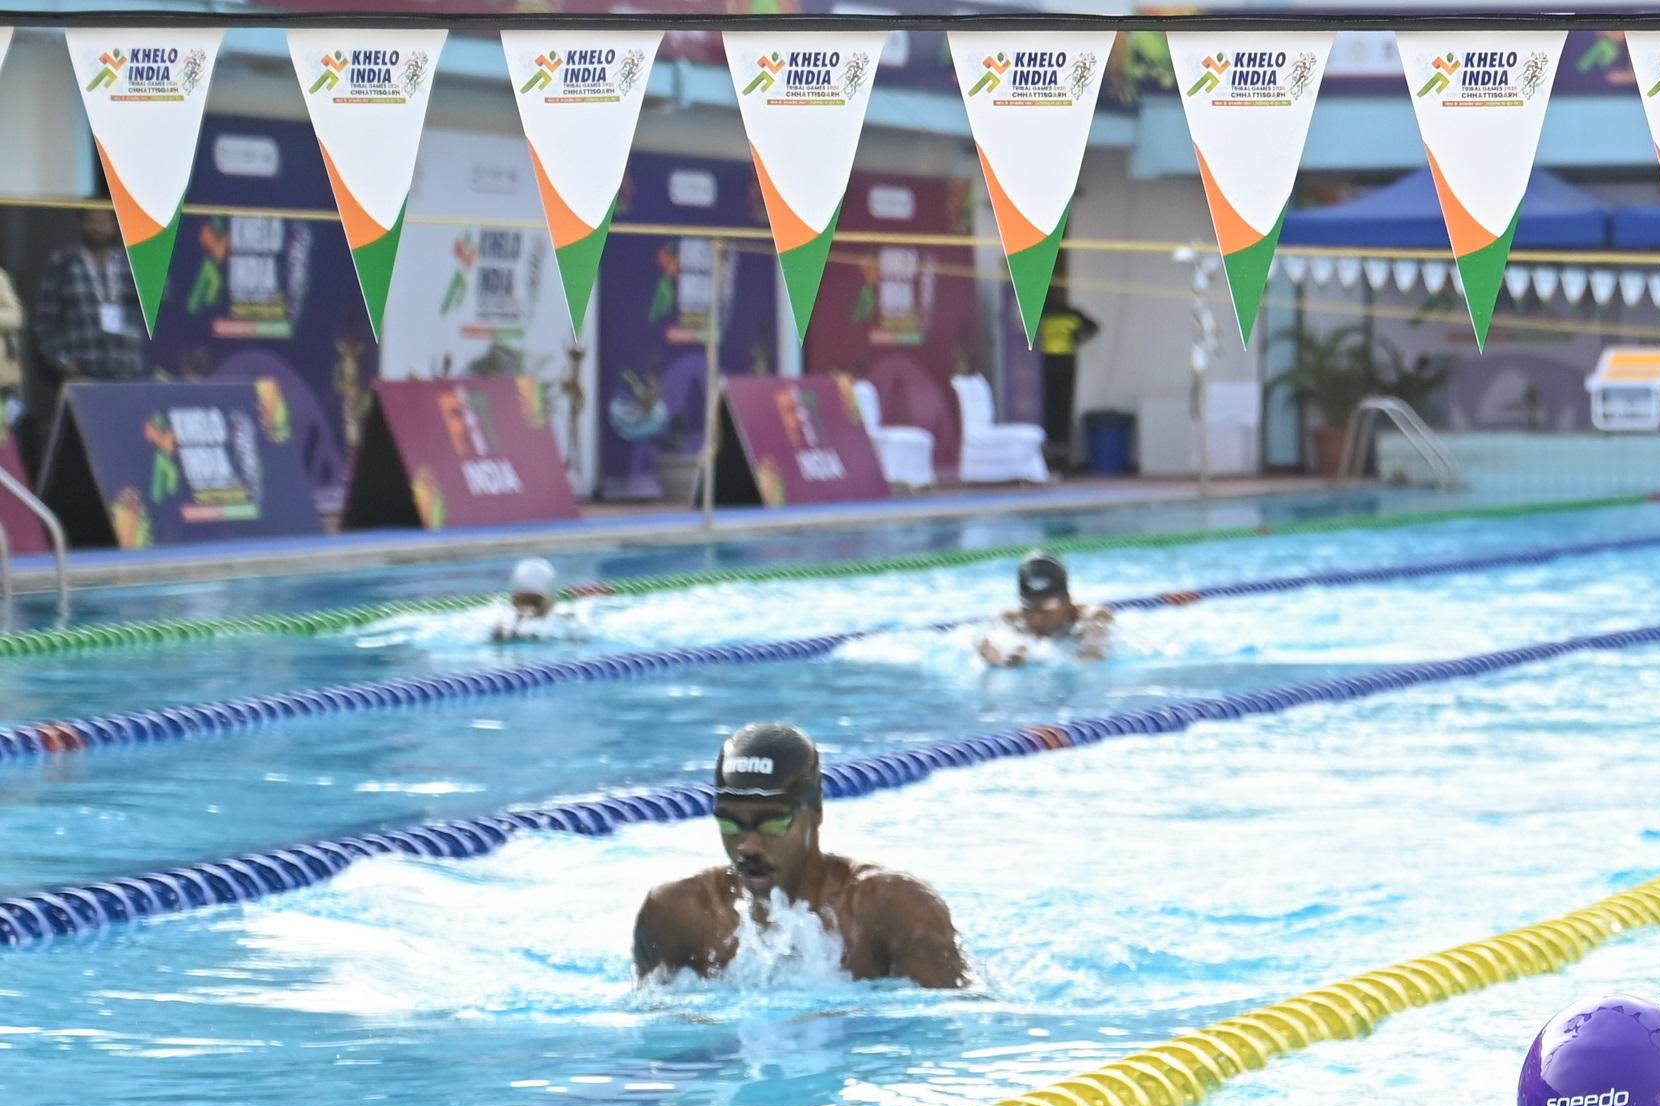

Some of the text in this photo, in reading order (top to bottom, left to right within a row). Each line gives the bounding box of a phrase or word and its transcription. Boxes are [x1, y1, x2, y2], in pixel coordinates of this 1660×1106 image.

[130, 47, 178, 64] KHELO
[351, 49, 399, 66] KHELO
[566, 49, 615, 65] KHELO
[789, 51, 840, 68] KHELO
[1015, 51, 1067, 68] KHELO
[1234, 51, 1286, 68] KHELO
[1464, 51, 1518, 68] KHELO
[128, 65, 170, 81] INDIA
[349, 67, 391, 83] INDIA
[563, 67, 606, 83] INDIA
[786, 69, 831, 85] INDIA
[1012, 70, 1057, 86] INDIA
[1231, 70, 1277, 86] INDIA
[1462, 70, 1508, 86] INDIA
[1230, 91, 1286, 99] CHHATTISGARH
[722, 756, 774, 774] arena
